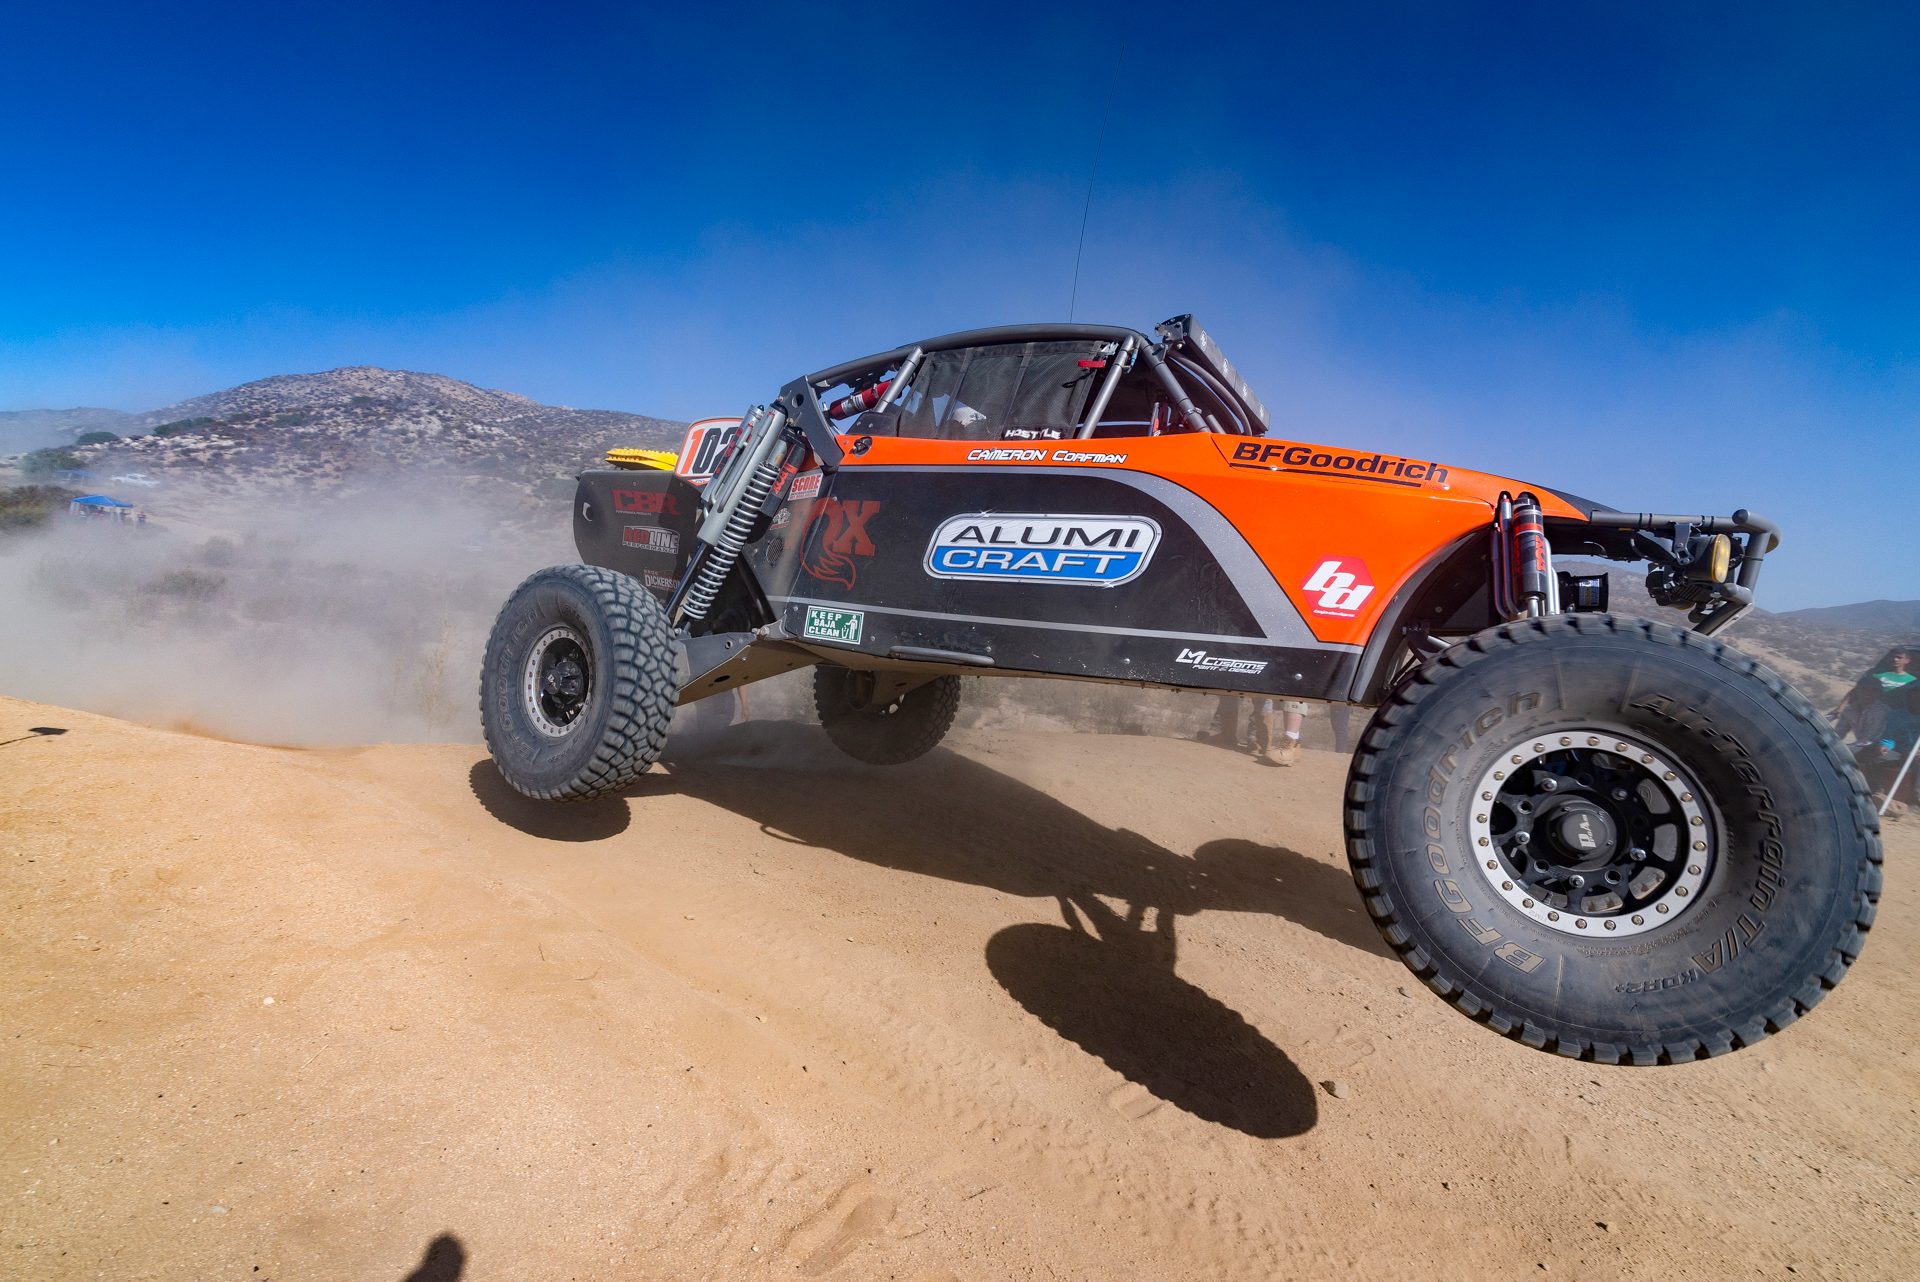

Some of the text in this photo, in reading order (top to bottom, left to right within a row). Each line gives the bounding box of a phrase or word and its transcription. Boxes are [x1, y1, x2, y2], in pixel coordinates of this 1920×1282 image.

[1232, 442, 1449, 483] BFGoodrich
[791, 474, 822, 492] SCORE
[950, 525, 1140, 548] ALUMI
[942, 550, 1126, 574] CRAFT
[811, 610, 842, 621] KEEP
[813, 618, 836, 629] BAJA
[808, 626, 840, 637] CLEAN
[1423, 692, 1546, 974] BFGoodrich
